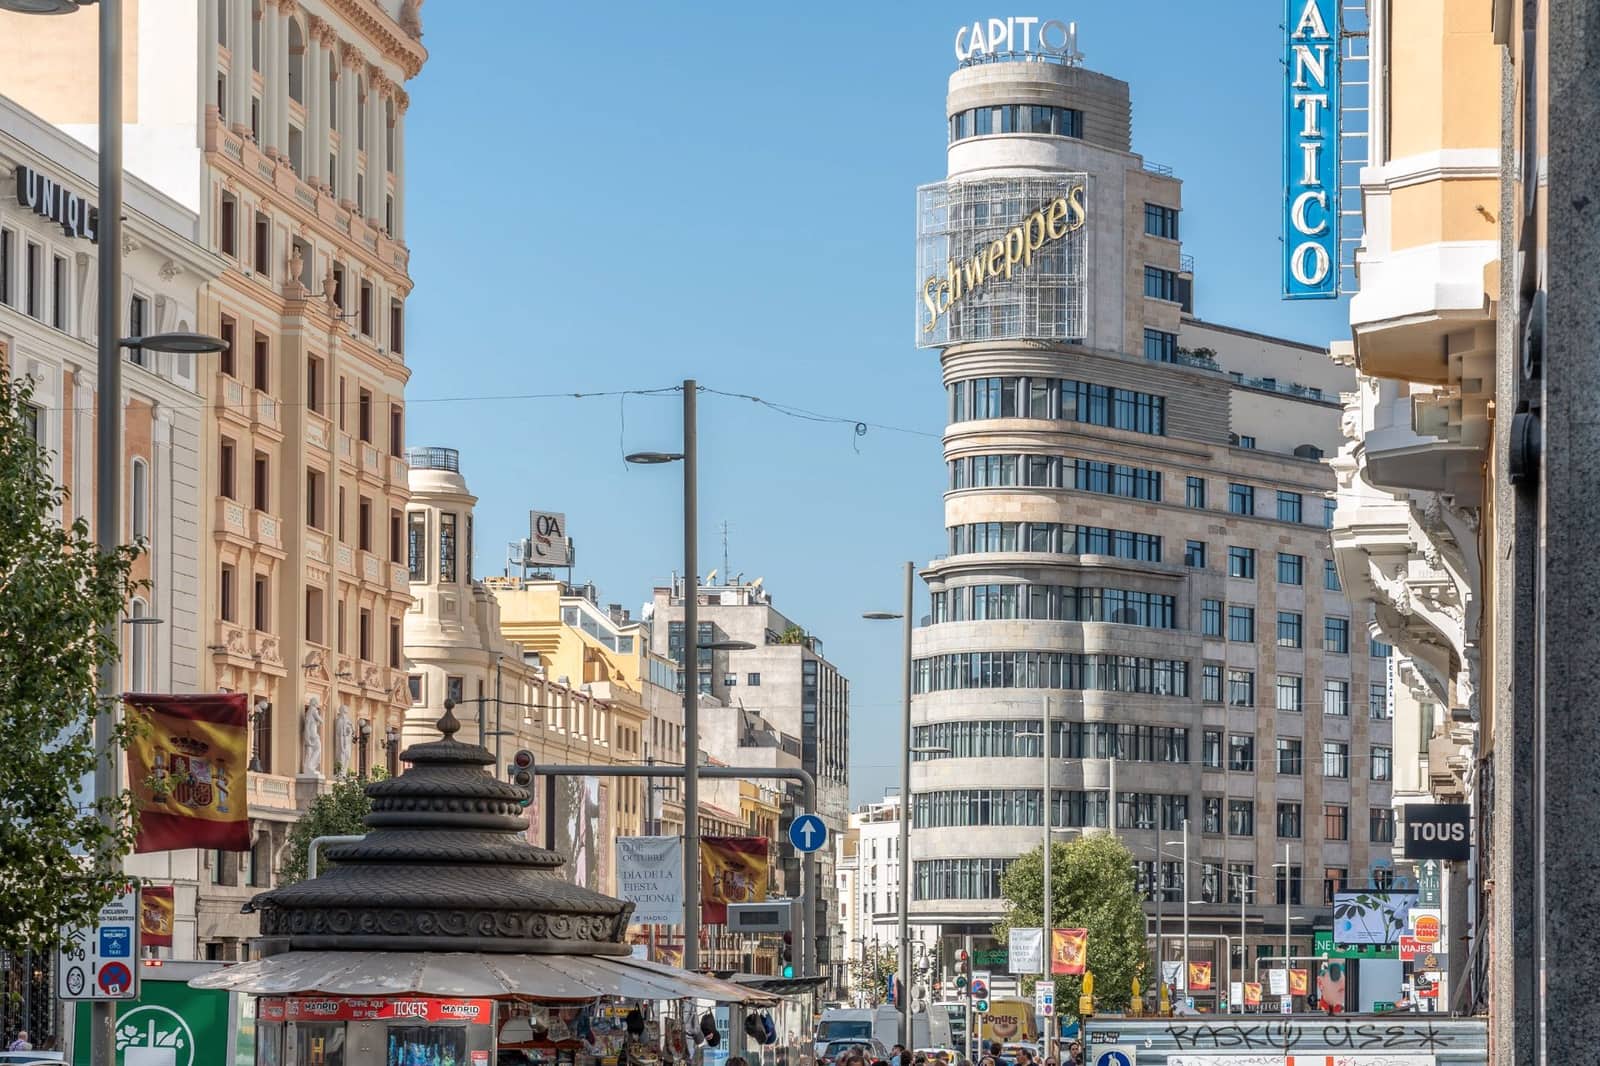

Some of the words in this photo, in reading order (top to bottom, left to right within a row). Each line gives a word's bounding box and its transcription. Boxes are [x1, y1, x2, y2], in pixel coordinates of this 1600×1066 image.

[1290, 0, 1330, 287] ANTICO
[20, 166, 98, 241] UNIQL
[923, 185, 1085, 333] Schweppes
[1410, 822, 1465, 841] TOUS
[623, 882, 658, 892] FIESTA
[1416, 929, 1439, 937] KING
[1401, 945, 1433, 953] VIAJES
[304, 1001, 338, 1012] MADRID
[394, 1001, 428, 1016] TICKETS
[441, 1005, 480, 1014] MADRID
